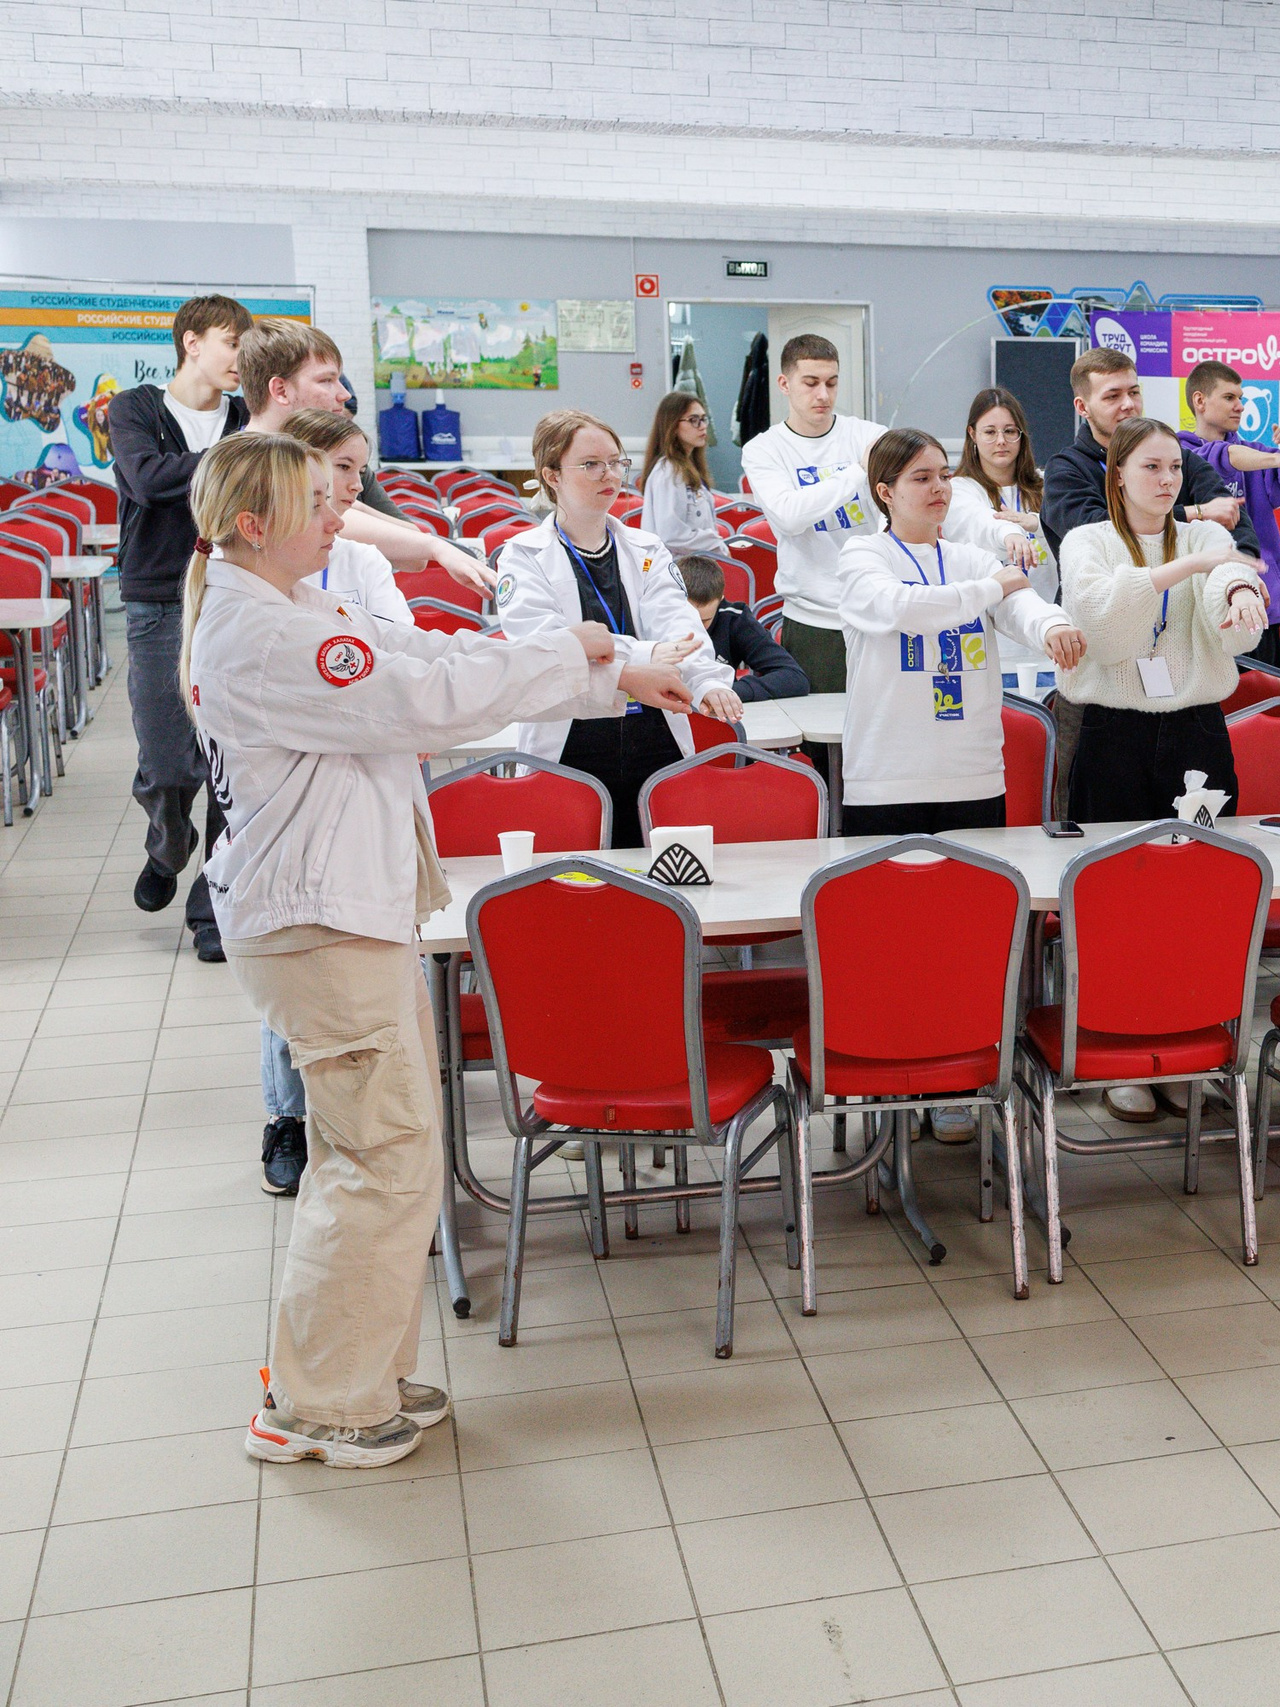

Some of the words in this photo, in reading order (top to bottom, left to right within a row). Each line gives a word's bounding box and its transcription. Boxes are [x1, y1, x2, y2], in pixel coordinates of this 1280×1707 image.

[728, 262, 766, 276] ВЫХОД
[31, 295, 97, 308] РОССИЙСКИЕ
[100, 297, 171, 310] СТУДЕНЧЕСКИЕ
[77, 312, 142, 325] РОССИЙСКИЕ
[1102, 333, 1126, 343] ТРУД
